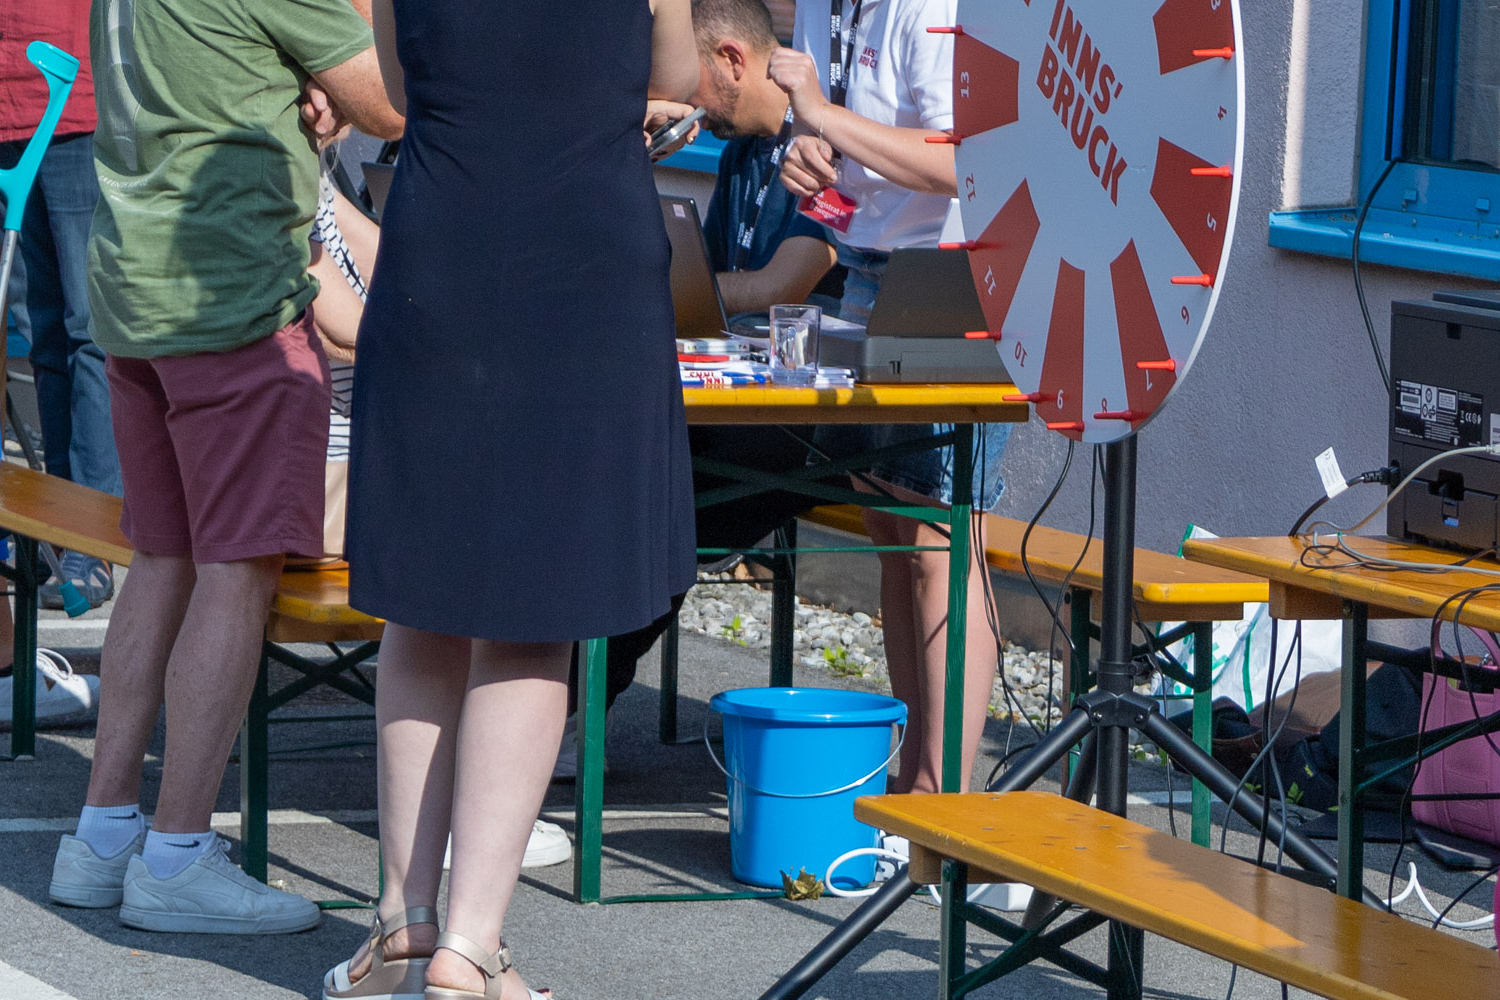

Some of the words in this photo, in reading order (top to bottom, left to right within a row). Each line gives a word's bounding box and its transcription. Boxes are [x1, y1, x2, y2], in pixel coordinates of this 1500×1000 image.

[960, 70, 969, 98] 13
[1036, 42, 1128, 207] BRUCK
[1217, 105, 1228, 121] 4
[965, 173, 976, 202] 12
[1206, 212, 1217, 232] 5
[984, 266, 997, 296] 11
[1014, 340, 1028, 368] 10
